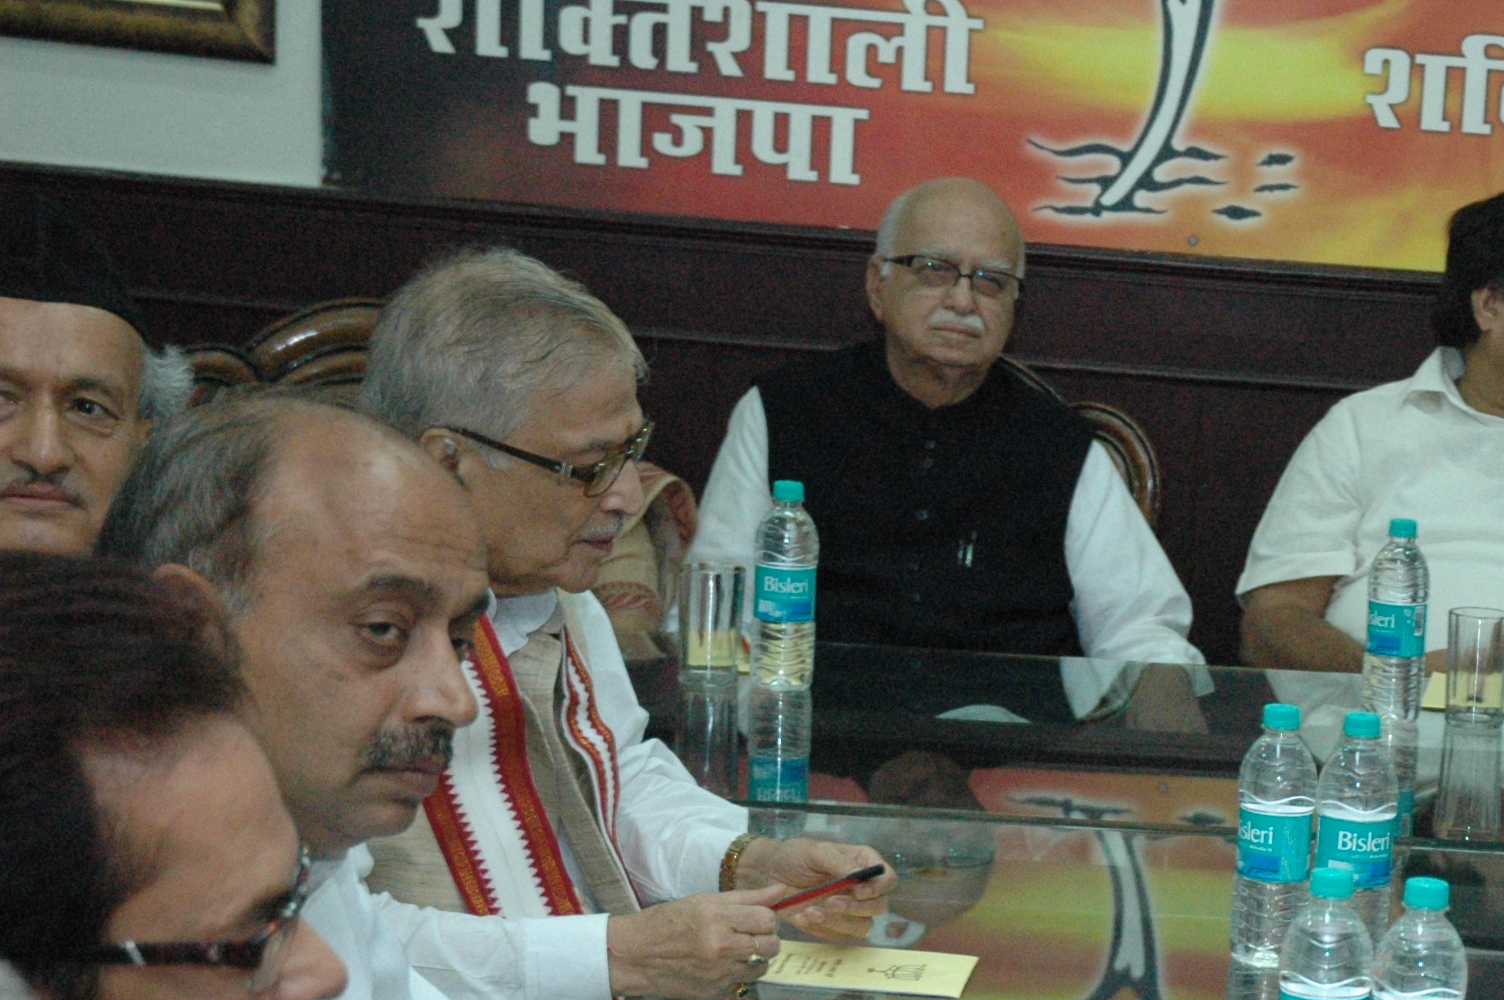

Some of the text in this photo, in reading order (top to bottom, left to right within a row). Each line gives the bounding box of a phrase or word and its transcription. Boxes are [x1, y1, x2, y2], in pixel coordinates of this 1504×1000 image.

[527, 81, 871, 186] भाजपा
[764, 575, 809, 594] Bisleri
[1337, 830, 1391, 853] Bisleri
